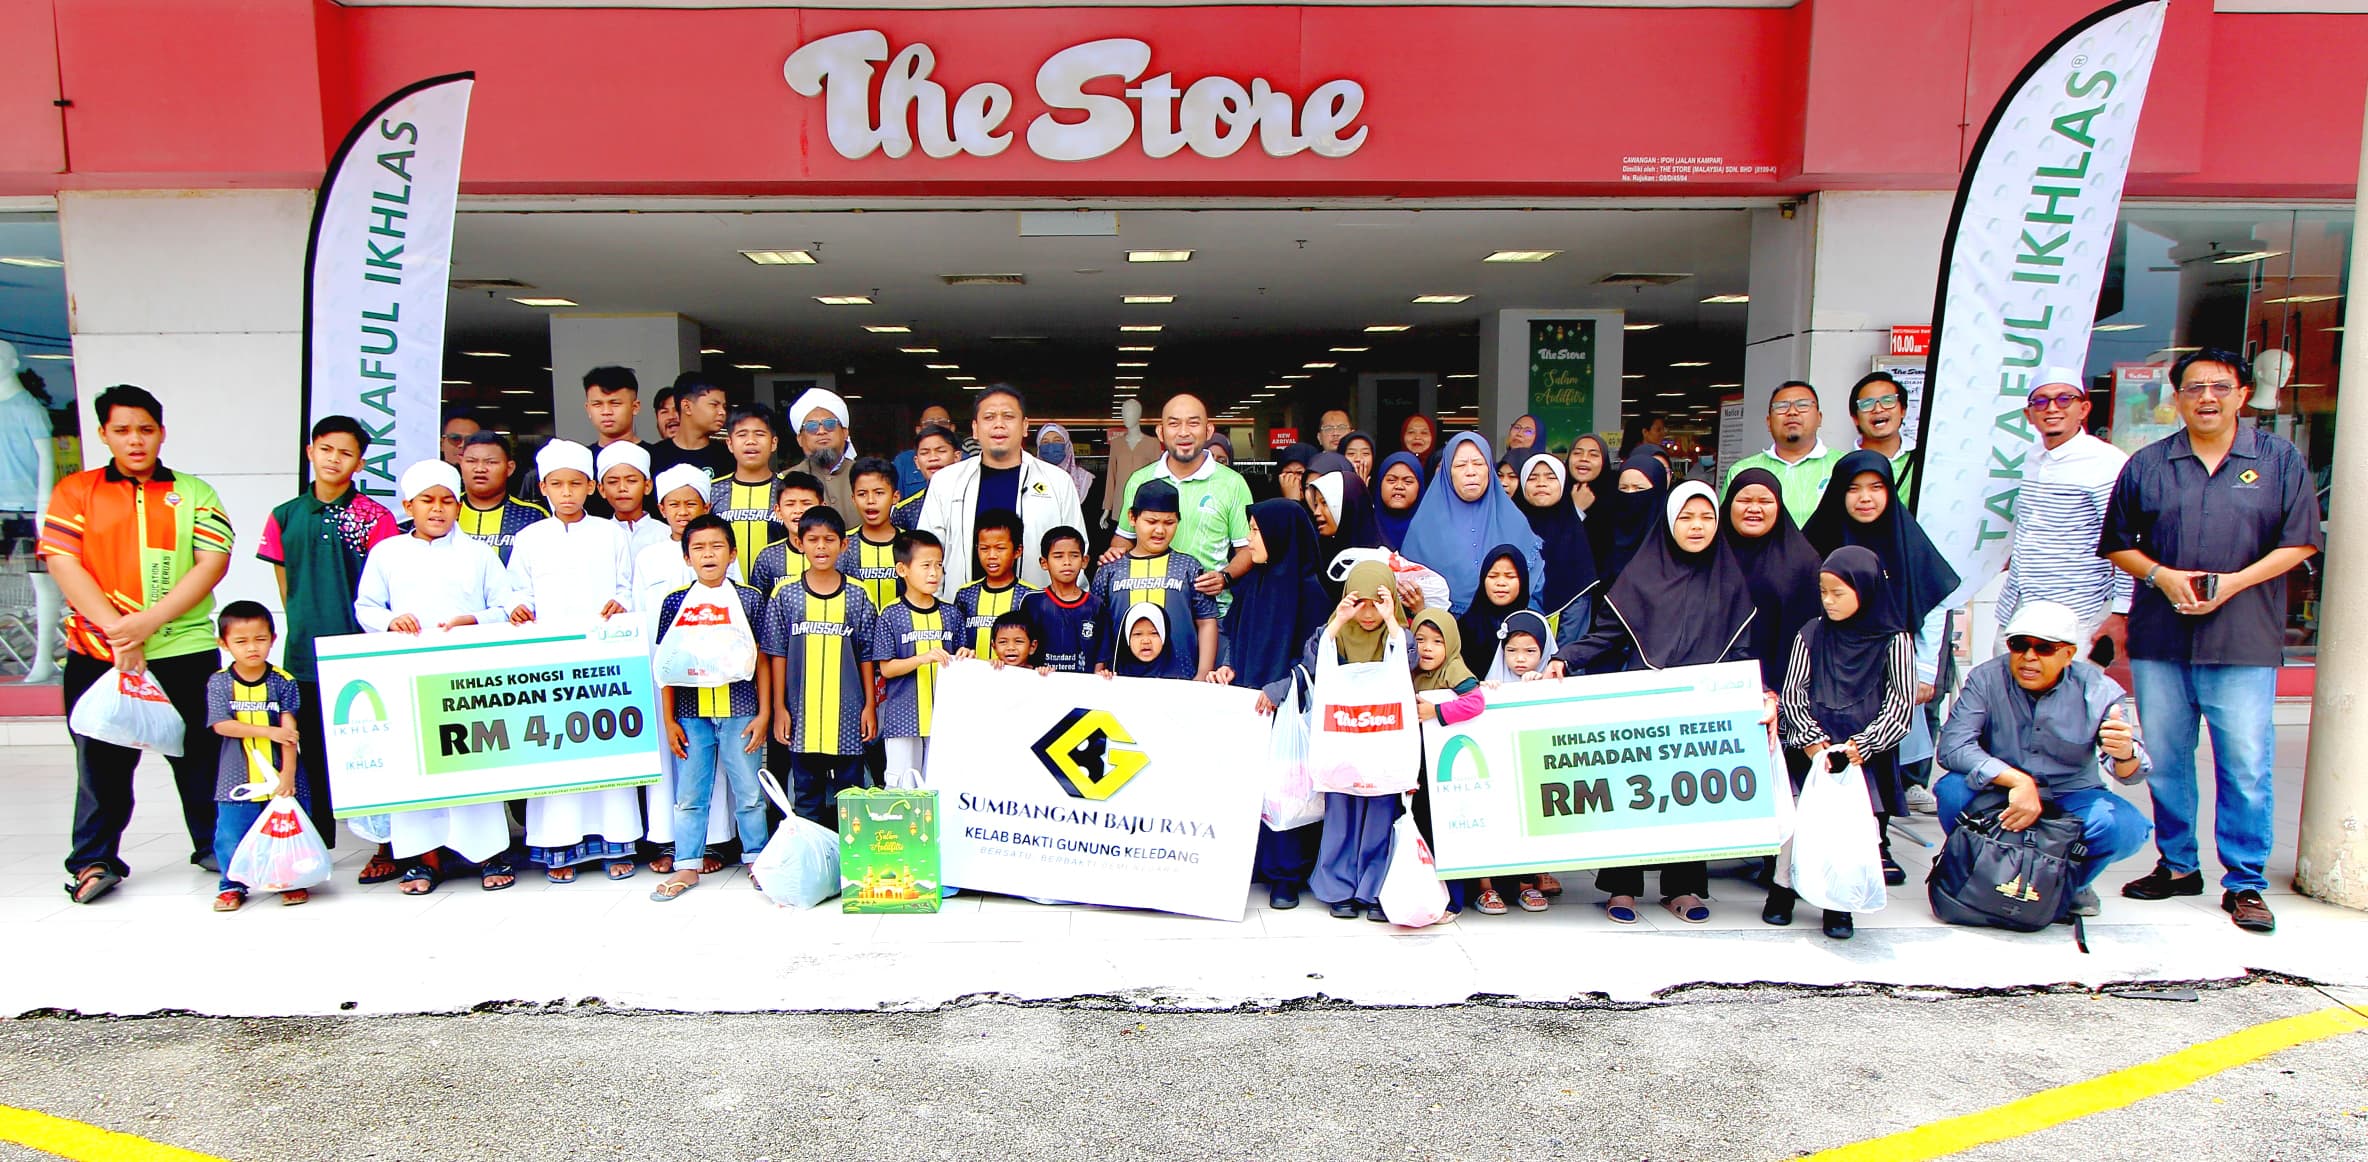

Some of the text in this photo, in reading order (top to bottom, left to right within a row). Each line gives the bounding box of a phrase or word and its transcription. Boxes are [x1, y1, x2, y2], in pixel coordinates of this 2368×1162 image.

[783, 29, 1369, 162] The Store
[359, 118, 418, 497] TAKAFUL IKHLAS
[1113, 577, 1183, 592] DARUSSALAM
[1045, 653, 1076, 661] Standard
[450, 665, 621, 690] IKHLAS KONGSI REZEKI
[442, 682, 632, 712] RAMADAN SYAWAL
[333, 722, 390, 736] IKHLAS
[439, 706, 644, 757] RM 4,000
[1333, 711, 1358, 727] The
[1552, 720, 1733, 747] IKHLAS KONGSI REZEKI
[346, 757, 384, 769] IKHLAS
[1543, 738, 1745, 770] RAMADAN SYAWAL
[1540, 765, 1757, 818] RM 3,000
[958, 792, 1217, 840] SUMBANGAN BAJU RAYA
[965, 826, 1200, 864] KELAB BAKTI GUNUNG KELEDANG
